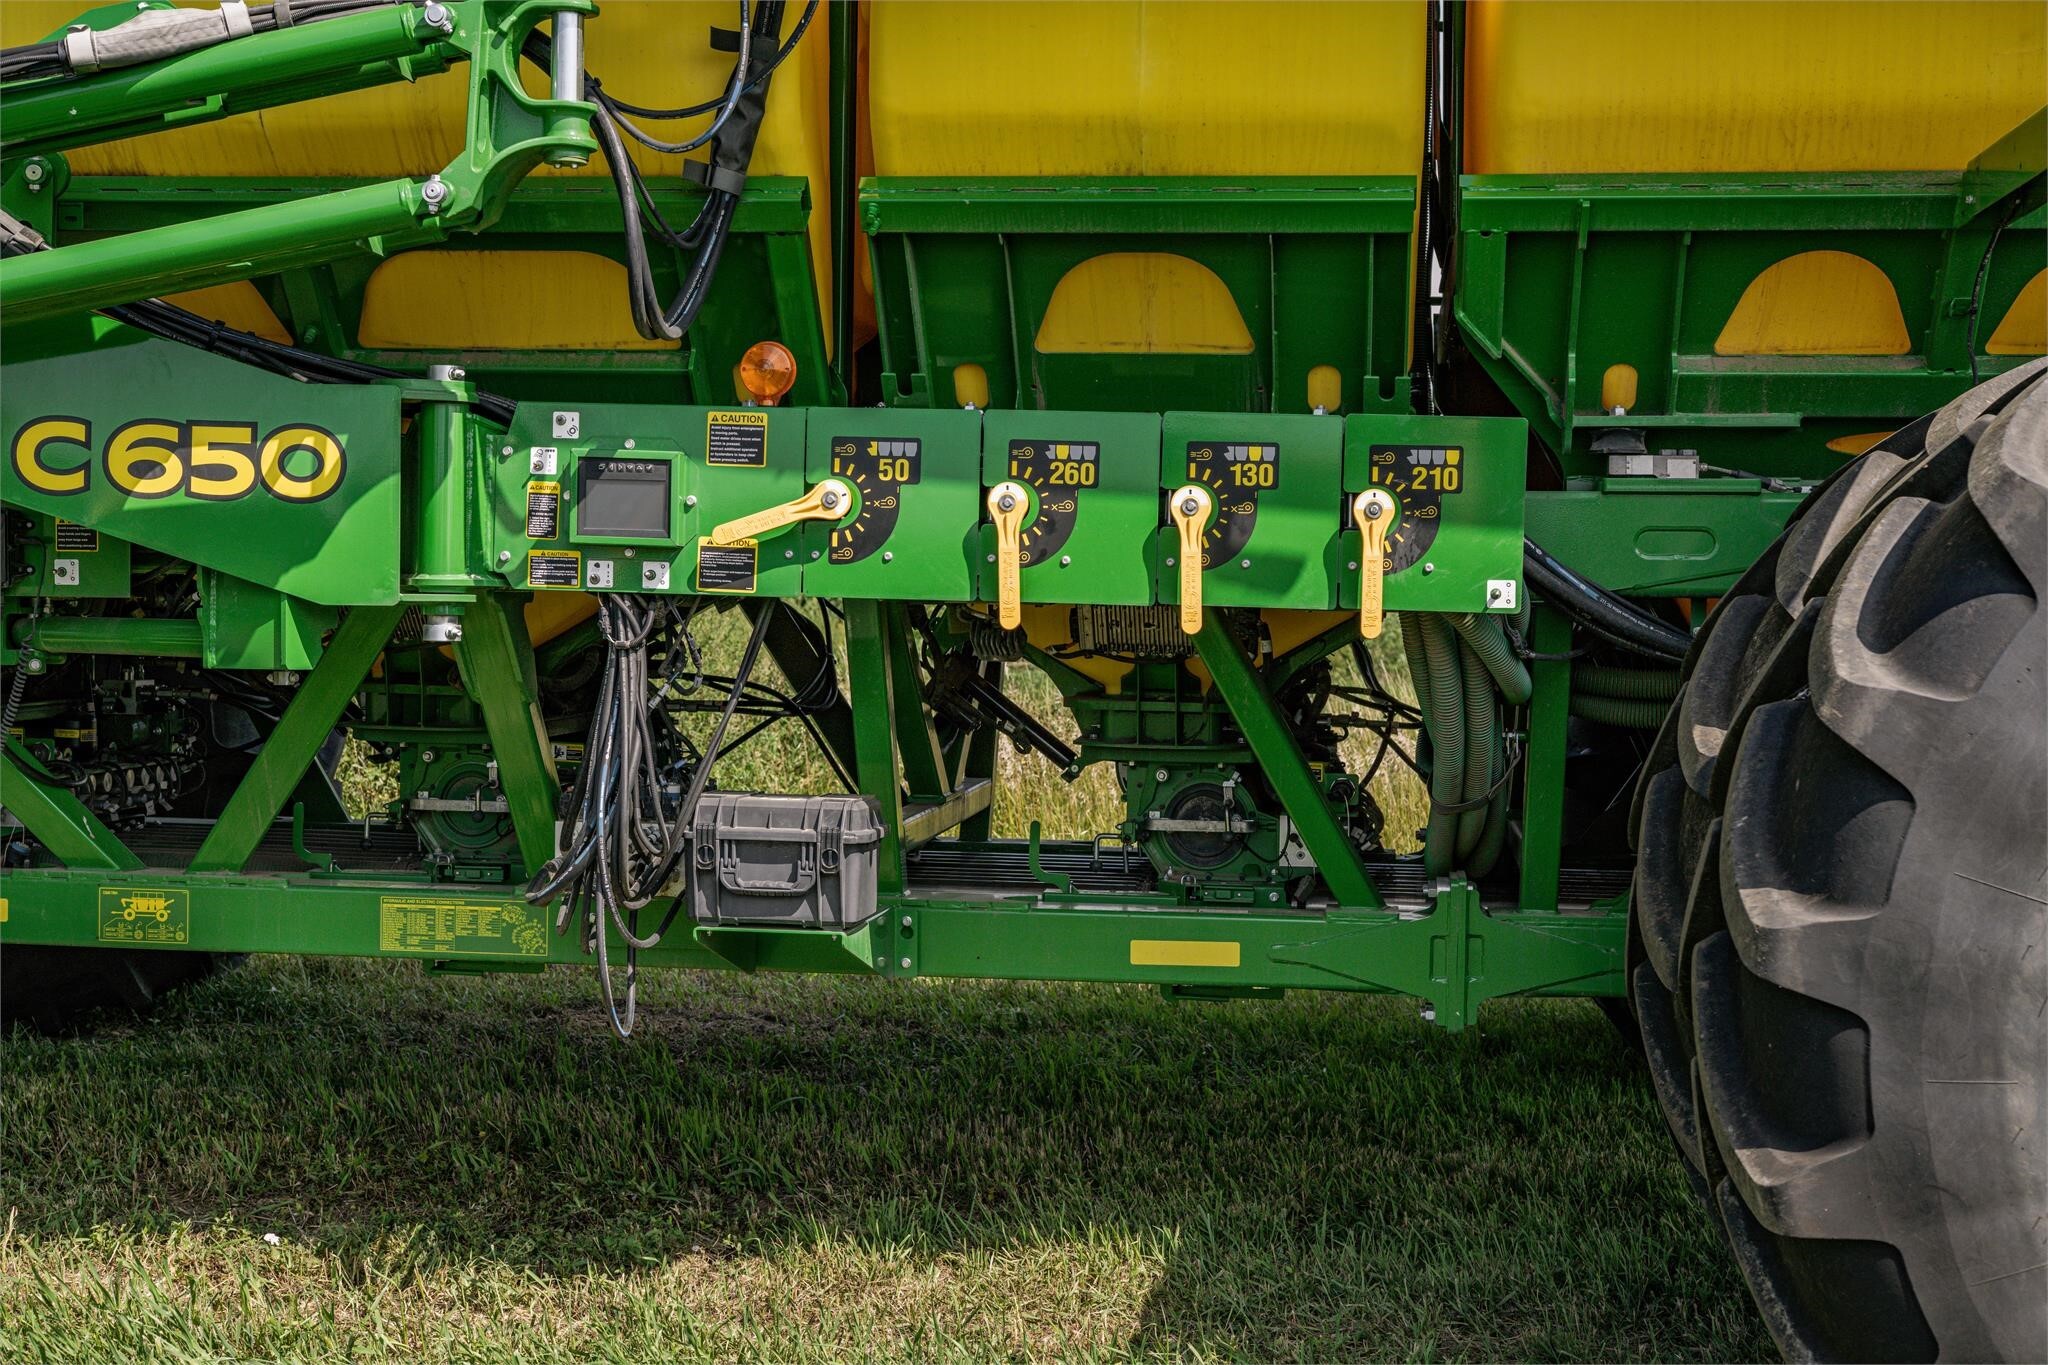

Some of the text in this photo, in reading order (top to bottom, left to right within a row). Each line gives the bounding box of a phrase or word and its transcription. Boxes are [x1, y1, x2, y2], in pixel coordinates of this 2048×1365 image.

[720, 414, 764, 423] CAUTION
[11, 415, 347, 504] C 650
[878, 458, 910, 481] 50
[1050, 461, 1095, 485] 260
[1229, 463, 1274, 486] 130
[1411, 467, 1459, 490] 210
